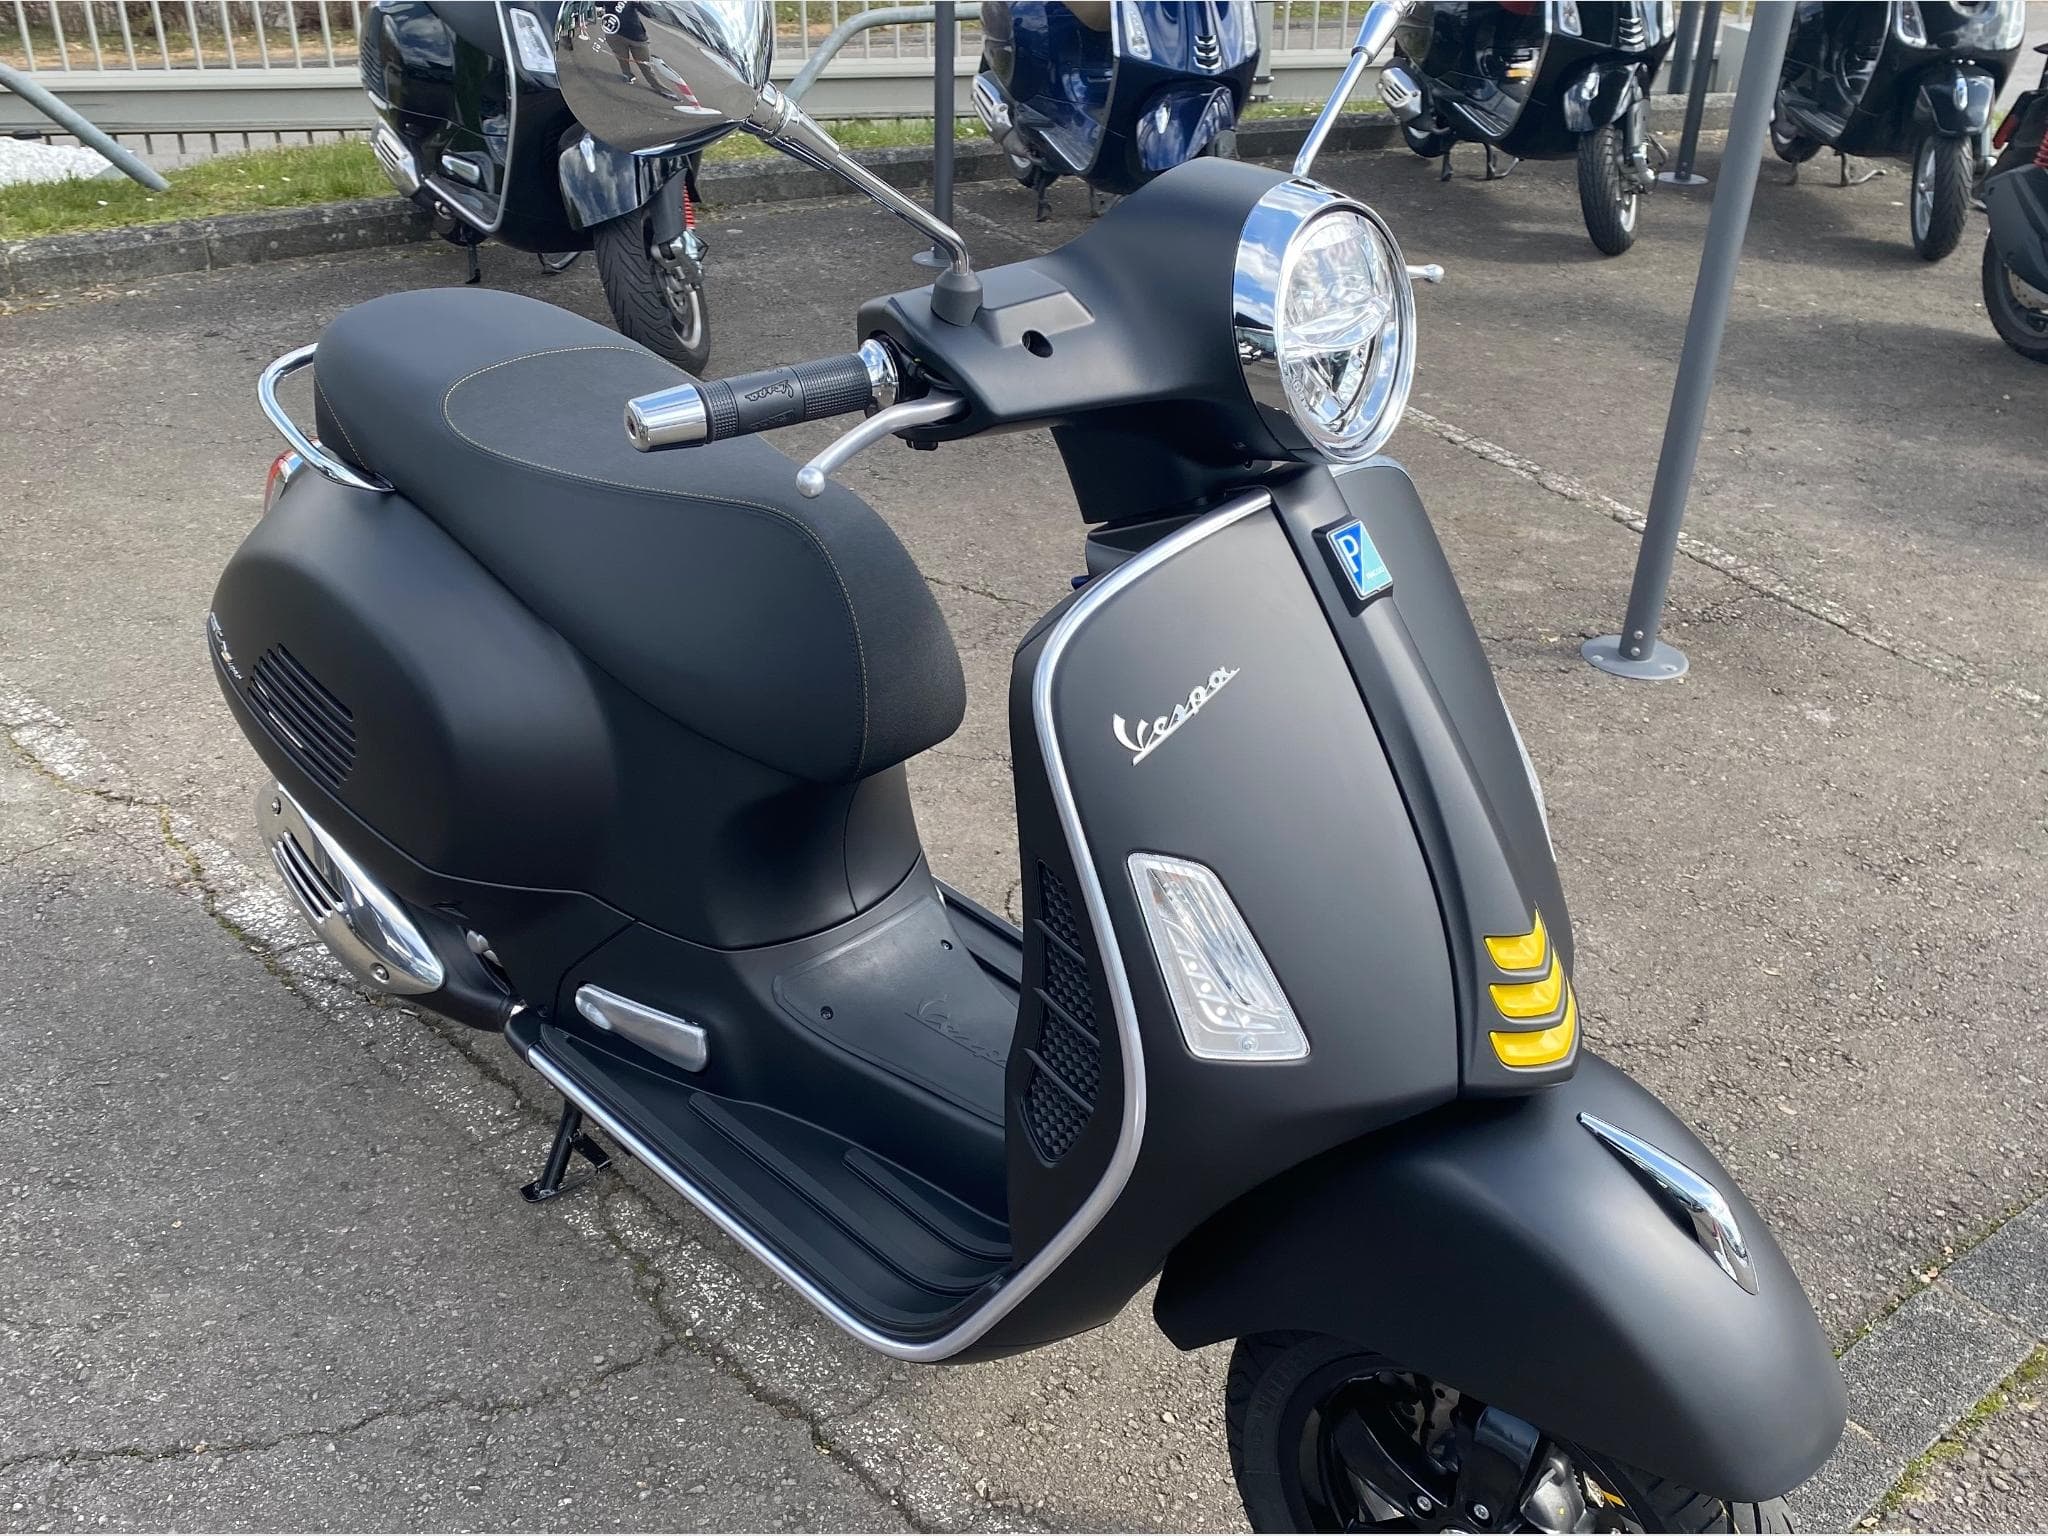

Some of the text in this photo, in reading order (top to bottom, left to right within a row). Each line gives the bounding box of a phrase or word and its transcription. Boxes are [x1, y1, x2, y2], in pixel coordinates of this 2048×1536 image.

[744, 379, 794, 402] Vespa
[1336, 534, 1360, 574] P
[1112, 666, 1240, 766] Vespa
